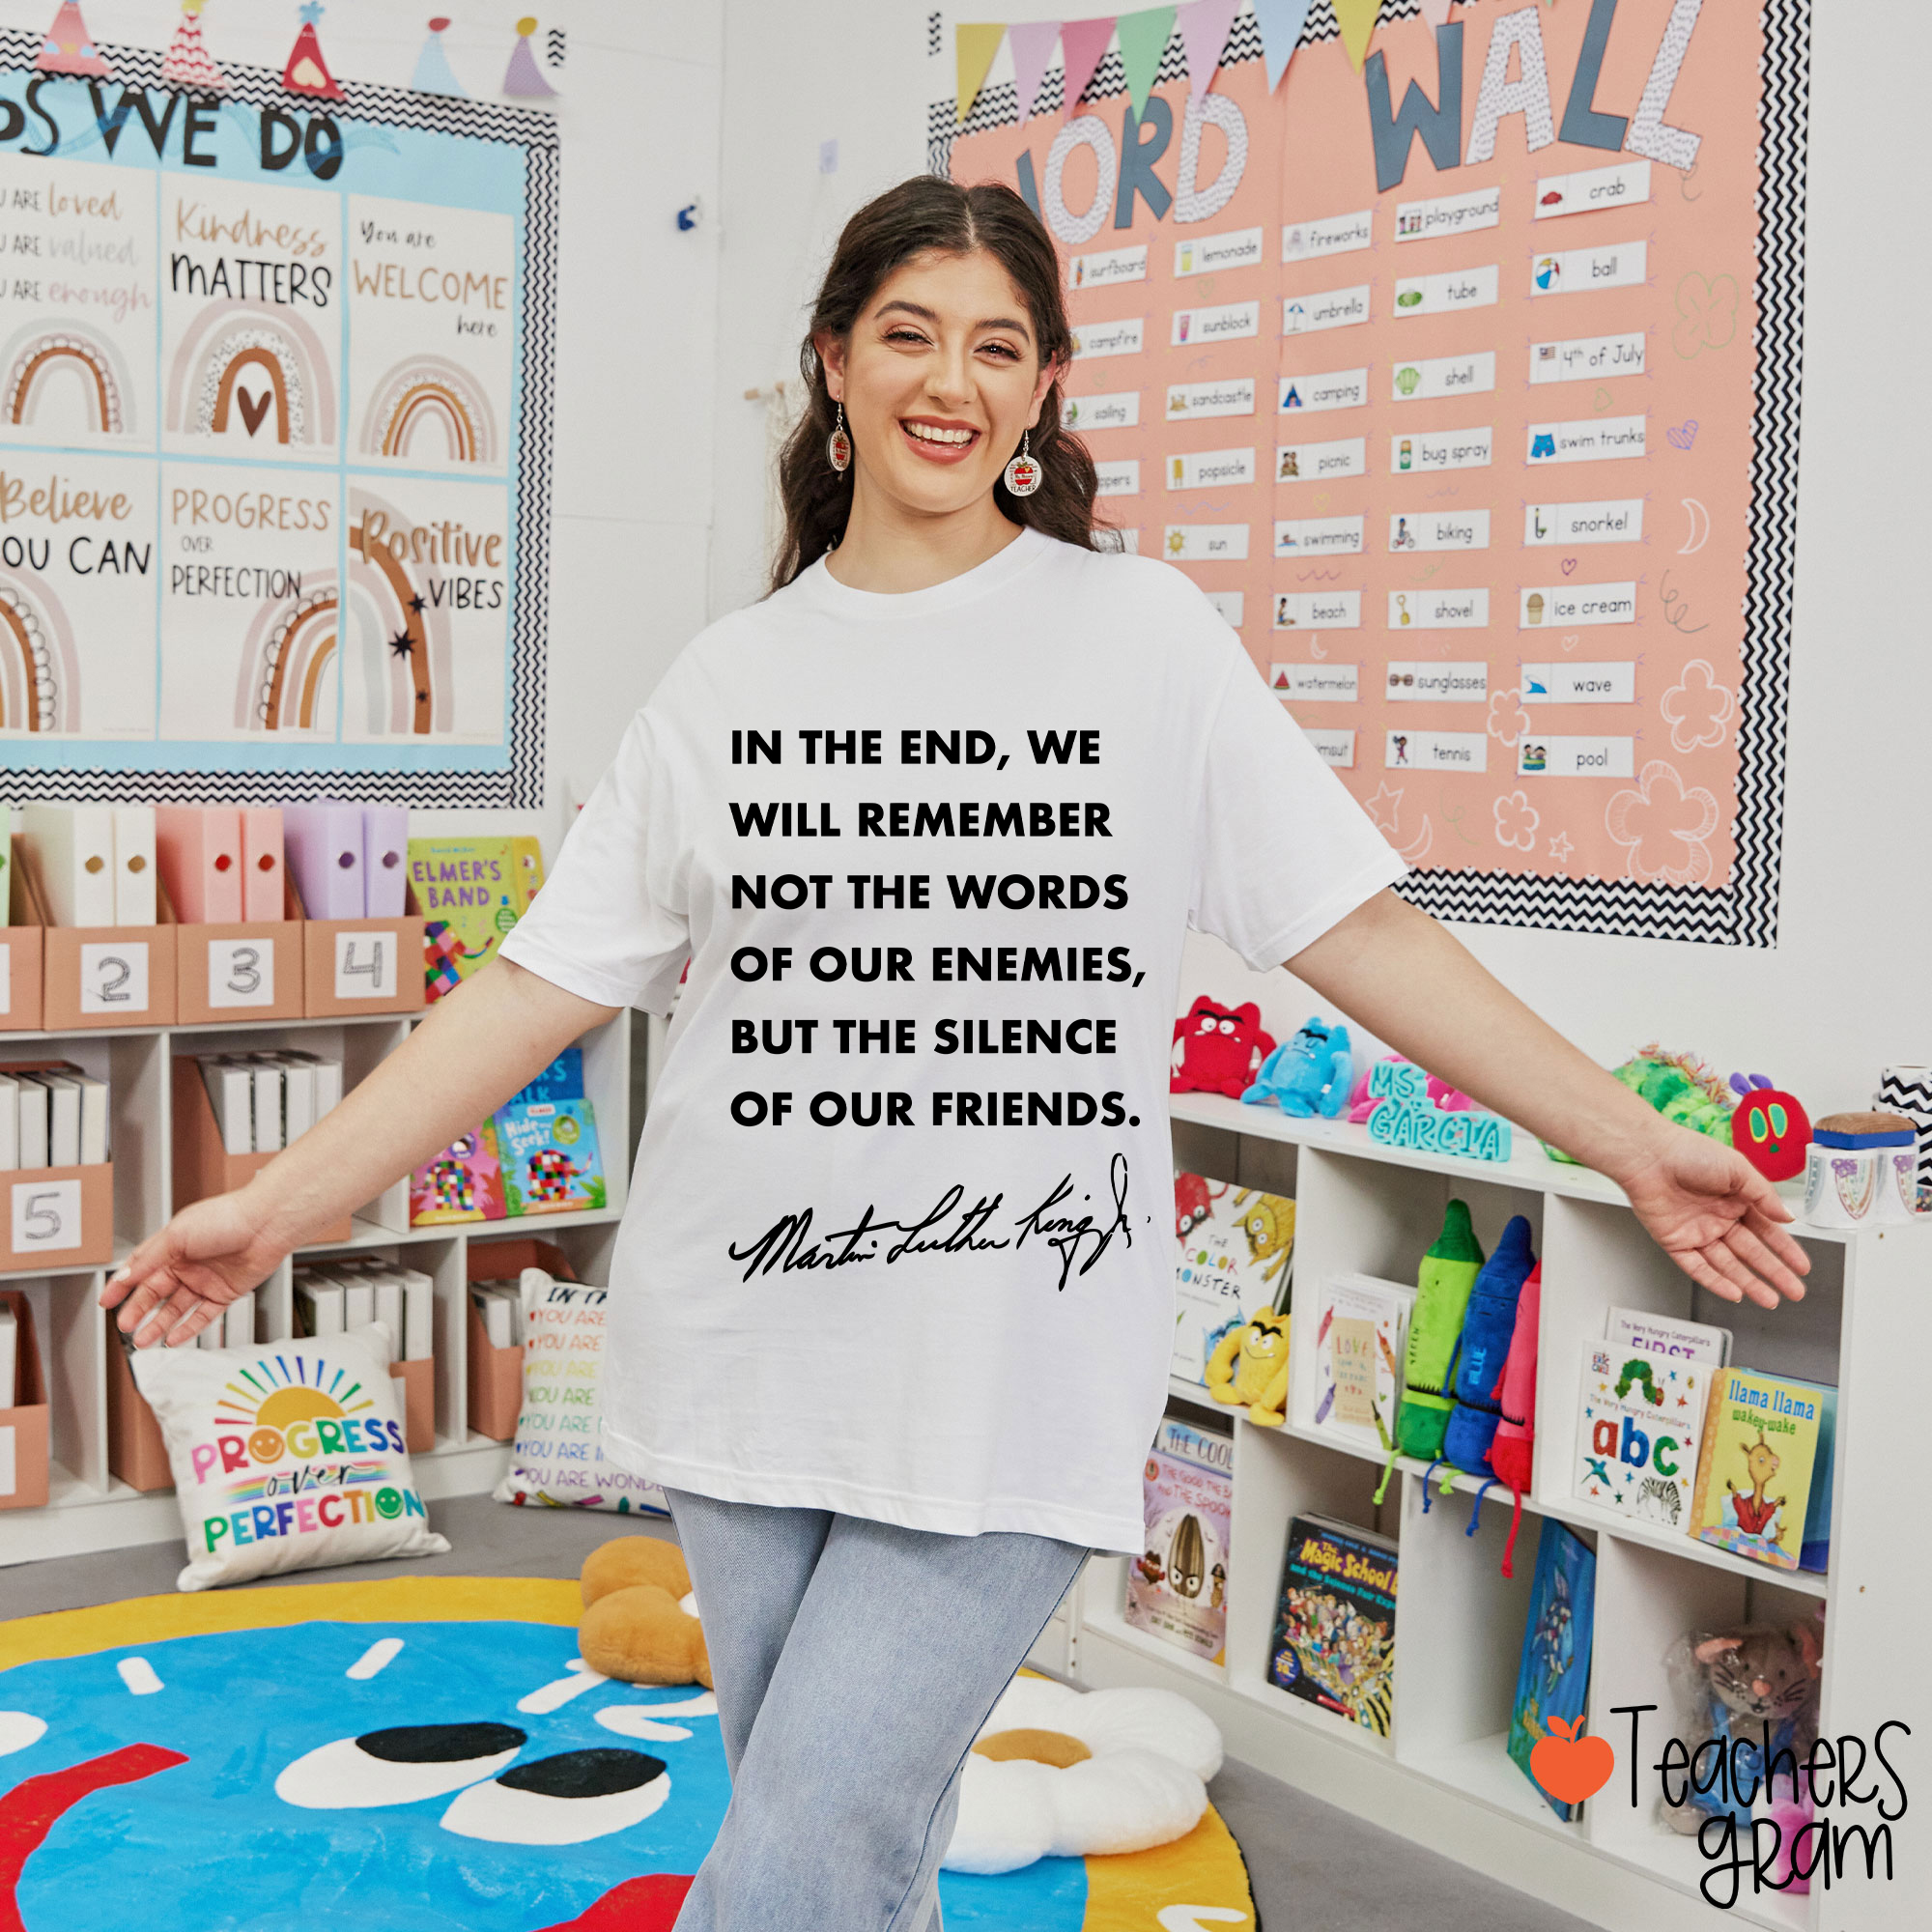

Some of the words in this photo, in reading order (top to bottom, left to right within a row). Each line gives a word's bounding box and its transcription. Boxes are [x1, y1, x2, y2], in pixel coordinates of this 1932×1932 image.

[1365, 0, 1703, 193] WALL
[86, 81, 222, 167] WE
[260, 108, 344, 181] DO
[1589, 177, 1626, 200] crab
[13, 188, 42, 213] ARE
[49, 181, 123, 221] loved
[1425, 199, 1497, 229] playground
[176, 197, 328, 258] Kindness
[360, 219, 397, 248] You
[404, 230, 437, 249] are
[1309, 228, 1369, 248] fireworks
[13, 234, 42, 257] ARE
[49, 229, 138, 267] valued
[1202, 242, 1257, 264] lemonade
[1090, 256, 1146, 278] surfboard
[1592, 256, 1618, 278] ball
[353, 259, 507, 310] WELCOME
[1446, 283, 1477, 300] tube
[13, 278, 42, 302] ARE
[49, 280, 152, 324] enough
[1314, 301, 1363, 323] umbrella
[455, 315, 497, 338] here
[1203, 316, 1251, 334] sunblock
[1089, 332, 1139, 351] campfire
[1589, 347, 1606, 367] of
[1611, 344, 1643, 364] July
[1444, 365, 1474, 386] shell
[1192, 389, 1253, 407] sandcastle
[1313, 384, 1360, 407] camping
[1094, 406, 1126, 422] sailing
[1559, 433, 1595, 450] swim
[1600, 428, 1644, 445] trunks
[1319, 454, 1350, 471] picnic
[1422, 444, 1447, 464] bug
[1452, 444, 1490, 464] spray
[1199, 460, 1246, 482] popsicle
[172, 488, 331, 531] PROGRESS
[1436, 523, 1473, 543] biking
[1571, 512, 1629, 533] snorkel
[181, 534, 213, 554] OVER
[360, 507, 503, 568] Positive
[1208, 538, 1228, 552] sun
[1304, 530, 1359, 551] swimming
[69, 536, 151, 575] CAN
[171, 564, 302, 600] PERFECTION
[428, 577, 505, 610] VIBES
[1312, 604, 1347, 620] beach
[1435, 600, 1473, 619] shovel
[1553, 603, 1577, 617] ice
[1581, 597, 1632, 614] cream
[1296, 676, 1356, 689] watermelon
[1418, 673, 1487, 694] sunglasses
[1573, 677, 1612, 693] wave
[732, 730, 781, 764] IN
[799, 730, 881, 764] THE
[901, 730, 1009, 770] END,
[1027, 730, 1099, 764] WE
[1433, 744, 1471, 762] tennis
[1576, 749, 1608, 769] pool
[728, 803, 840, 837] WILL
[859, 803, 1113, 837] REMEMBER
[412, 860, 501, 882] ELMER'S
[427, 886, 490, 908] BAND
[732, 874, 833, 909] NOT
[847, 875, 929, 909] THE
[947, 874, 1128, 909] WORDS
[227, 948, 262, 994] 3
[342, 941, 384, 988] 4
[731, 947, 792, 981] OF
[810, 947, 915, 981] OUR
[933, 947, 1145, 987] ENEMIES,
[98, 957, 131, 1002] 2
[732, 1020, 818, 1054] BUT
[834, 1020, 915, 1053] THE
[934, 1019, 1116, 1054] SILENCE
[731, 1092, 792, 1126] OF
[810, 1092, 915, 1126] OUR
[933, 1092, 1140, 1126] FRIENDS.
[504, 1118, 537, 1140] Hide
[1370, 1105, 1501, 1158] GARCIA
[511, 1129, 551, 1156] Seek!
[24, 1192, 62, 1240] 5
[728, 1204, 885, 1283] Martin
[887, 1184, 1009, 1264] Luther
[1014, 1173, 1103, 1292] King
[1208, 1235, 1229, 1248] THE
[1185, 1247, 1237, 1275] COLOR
[547, 1287, 578, 1304] IN
[536, 1309, 573, 1324] YOU
[574, 1310, 608, 1326] ARE
[536, 1333, 567, 1350] YOU
[569, 1334, 604, 1351] ARE
[1337, 1335, 1368, 1357] LOVE
[565, 1360, 599, 1378] ARE
[562, 1387, 596, 1406] ARE
[1728, 1378, 1769, 1411] llama
[1773, 1389, 1815, 1421] llama
[559, 1414, 593, 1434] ARE
[1732, 1407, 1797, 1437] wakey-wake
[191, 1418, 406, 1485] PROGRESS
[556, 1442, 590, 1462] ARE
[1170, 1428, 1191, 1454] THE
[1593, 1416, 1680, 1477] abc
[267, 1463, 377, 1496] over
[555, 1469, 588, 1488] ARE
[204, 1487, 426, 1553] PERFECTION
[1299, 1538, 1344, 1573] Magic
[1343, 1552, 1393, 1592] School
